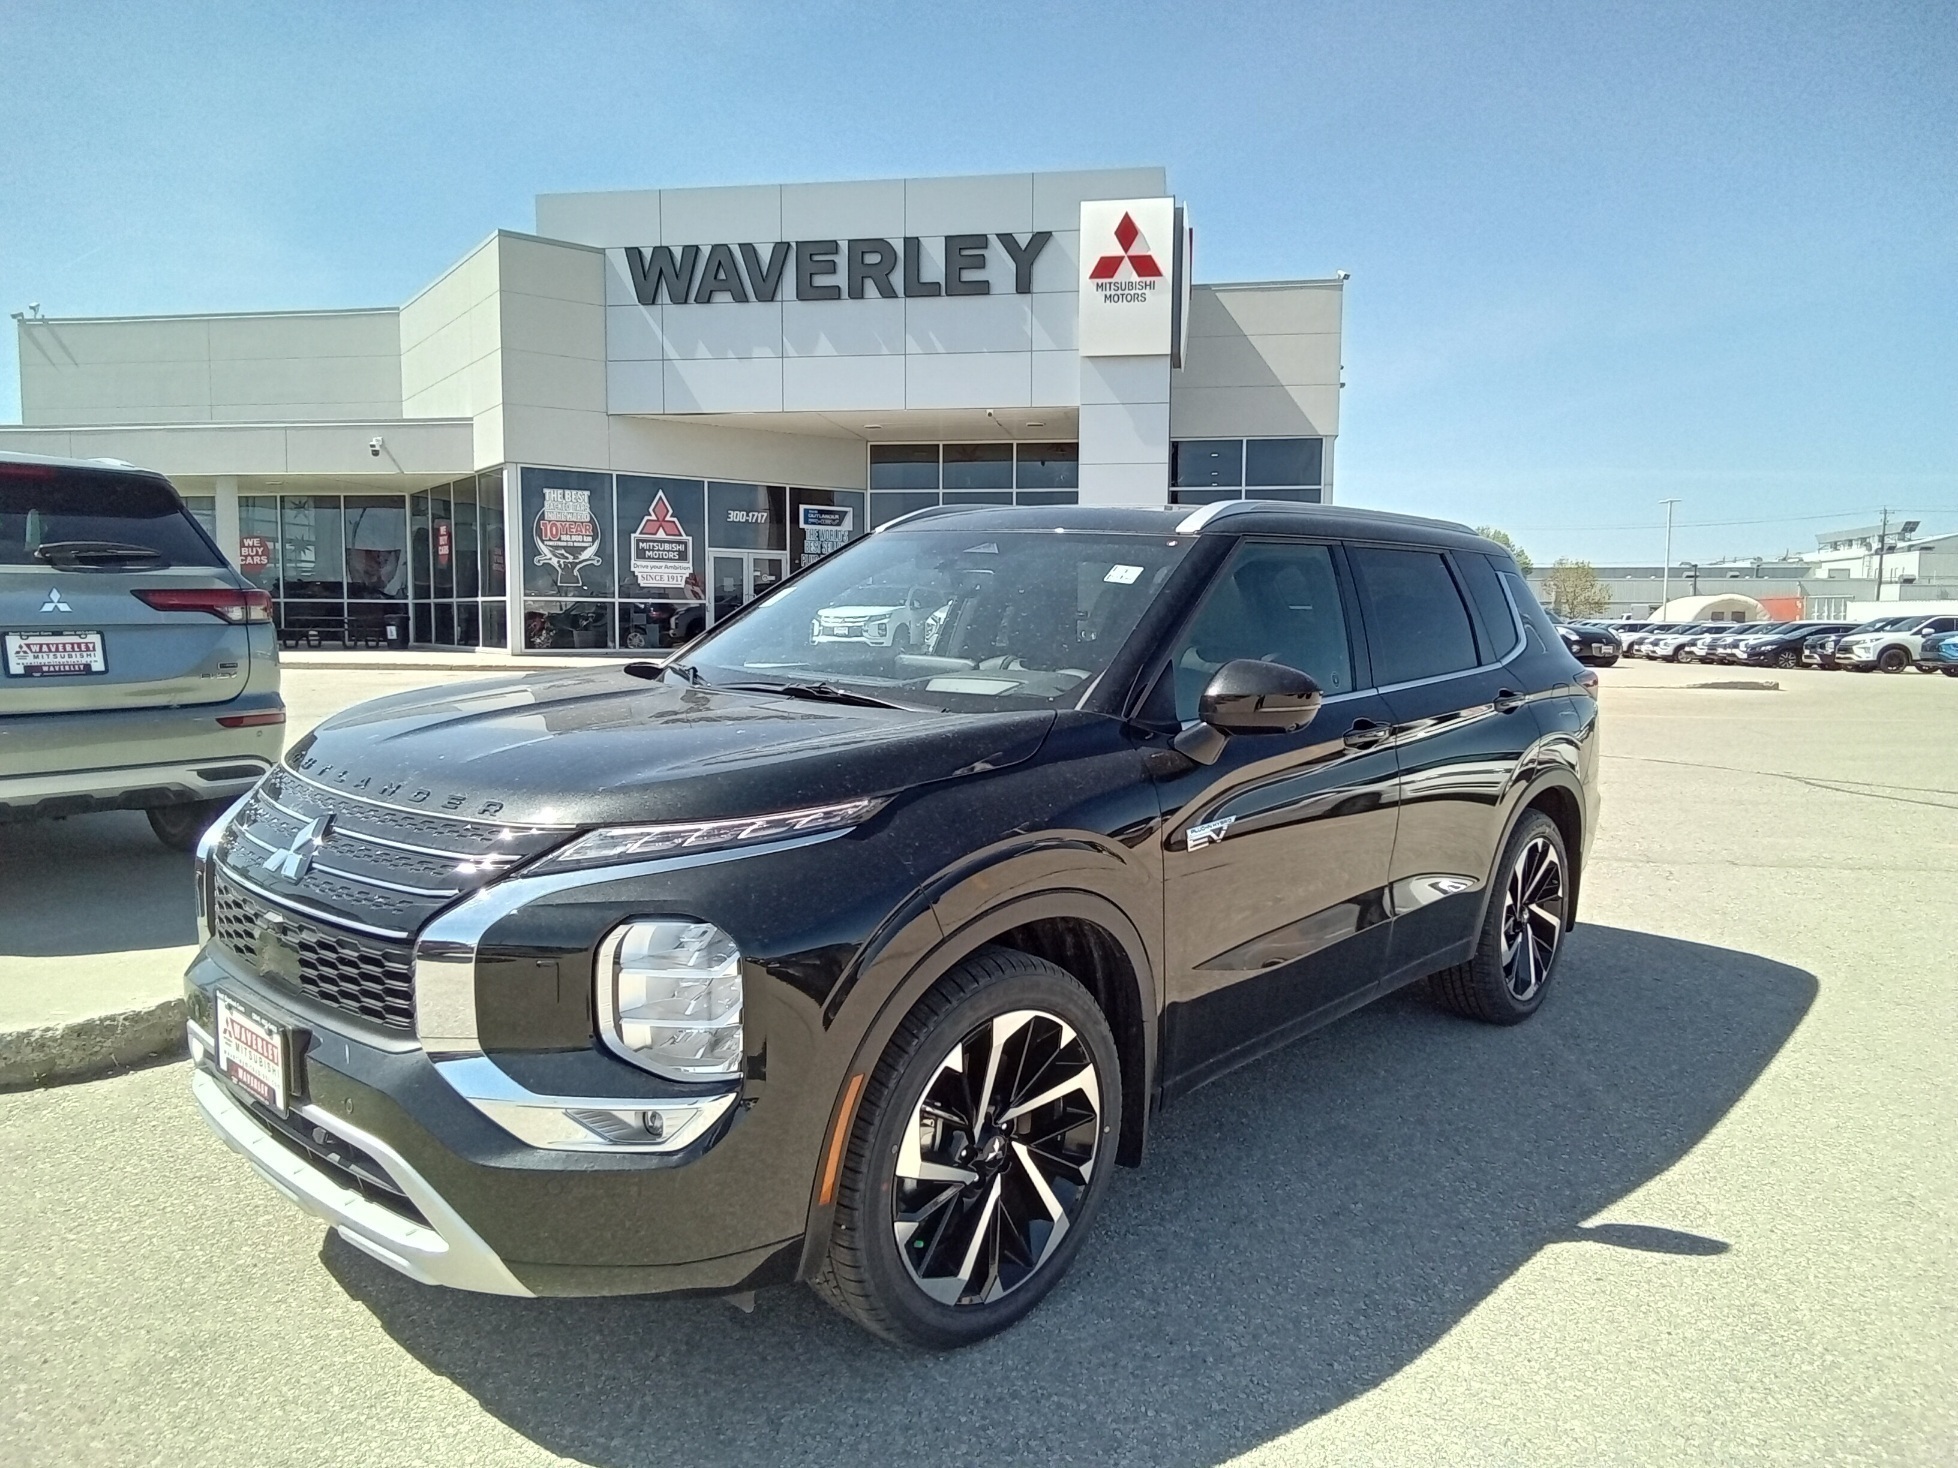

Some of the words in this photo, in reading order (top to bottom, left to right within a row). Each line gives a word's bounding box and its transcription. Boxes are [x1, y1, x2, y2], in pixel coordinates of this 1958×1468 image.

[624, 230, 1053, 304] WAVERLEY
[1096, 280, 1156, 292] MITSUBISHI
[1104, 292, 1147, 303] MOTORS
[543, 488, 563, 501] THE
[564, 489, 590, 503] BEST
[540, 521, 560, 540] 10
[559, 521, 593, 535] YEAR
[806, 529, 819, 541] THE
[820, 529, 849, 543] WORLD'S
[243, 538, 261, 547] WE
[639, 542, 685, 551] MITSUBISHI
[804, 540, 820, 554] BEST
[241, 547, 264, 556] BUY
[645, 551, 679, 559] MOTORS
[240, 556, 268, 565] CARS
[641, 574, 664, 582] SINCE
[667, 575, 684, 583] 1917
[29, 643, 96, 652] WAVERLEY
[292, 751, 504, 817] OUTLANDER
[1187, 824, 1229, 853] EV
[232, 1022, 279, 1067] WAVERLEY
[235, 1042, 281, 1078] MITSUBISHI
[237, 1067, 269, 1097] WAVERLEY
